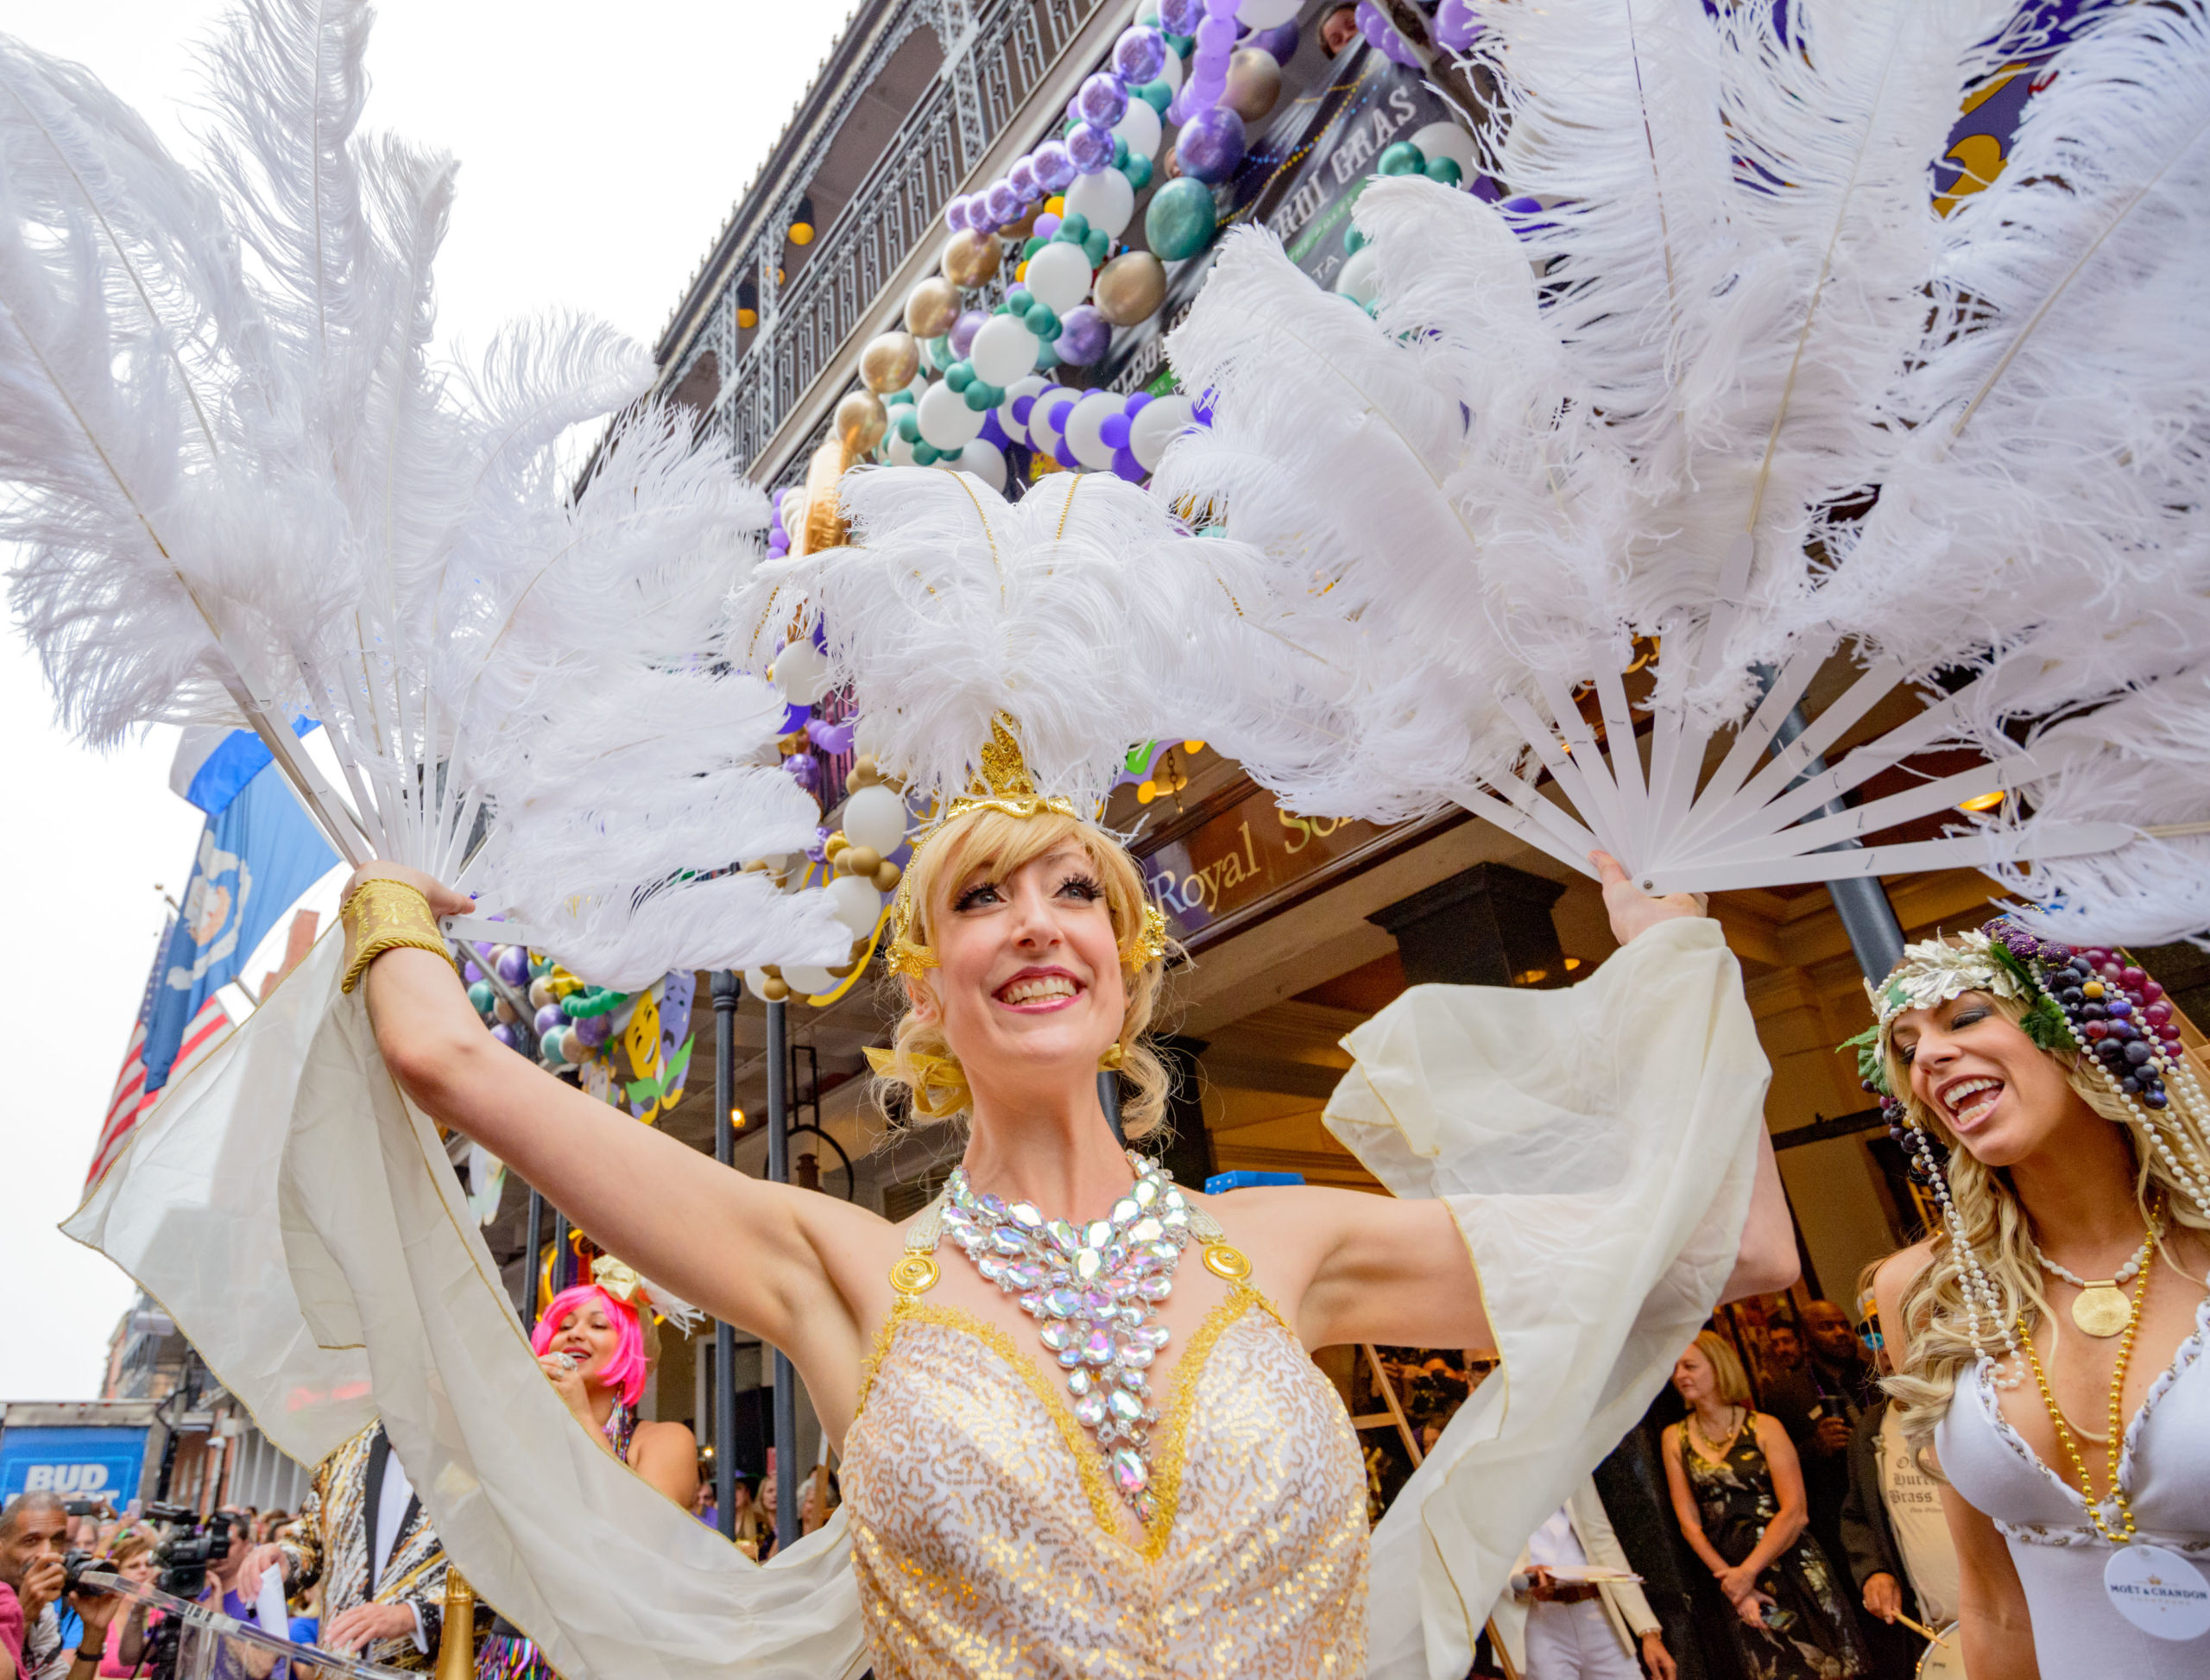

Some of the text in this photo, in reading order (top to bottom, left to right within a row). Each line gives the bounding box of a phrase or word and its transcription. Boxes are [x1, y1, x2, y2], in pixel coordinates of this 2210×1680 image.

[1279, 85, 1417, 242] RDI GRAS
[1148, 820, 1261, 920] Royal
[24, 1464, 109, 1494] BUD
[1889, 1489, 1933, 1504] Brass
[2151, 1587, 2208, 1600] CHANDON
